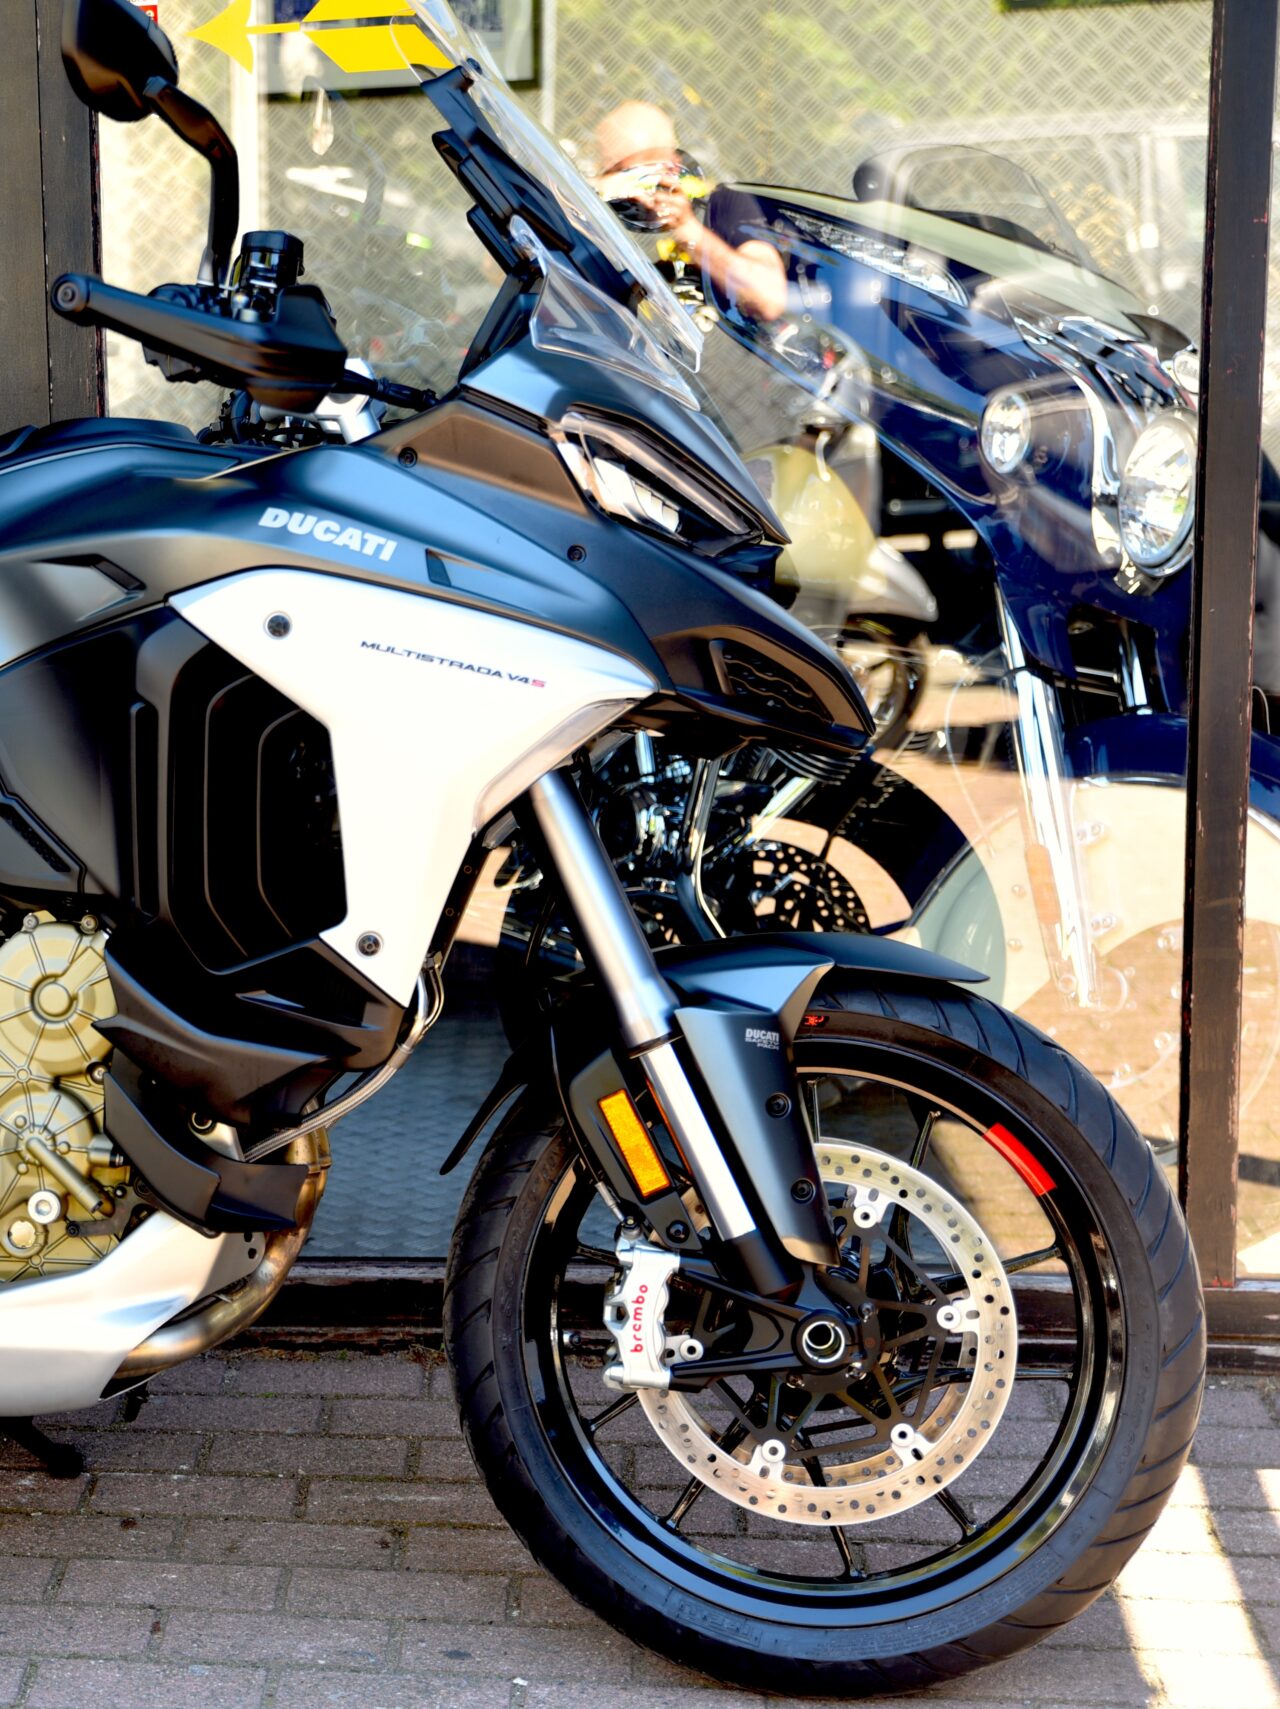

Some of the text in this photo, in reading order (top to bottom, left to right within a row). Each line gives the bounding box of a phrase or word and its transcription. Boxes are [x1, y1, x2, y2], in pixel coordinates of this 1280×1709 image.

[258, 507, 398, 562] DUCATI
[360, 641, 503, 679] MULTISTRADA
[745, 1028, 780, 1042] DUCATI
